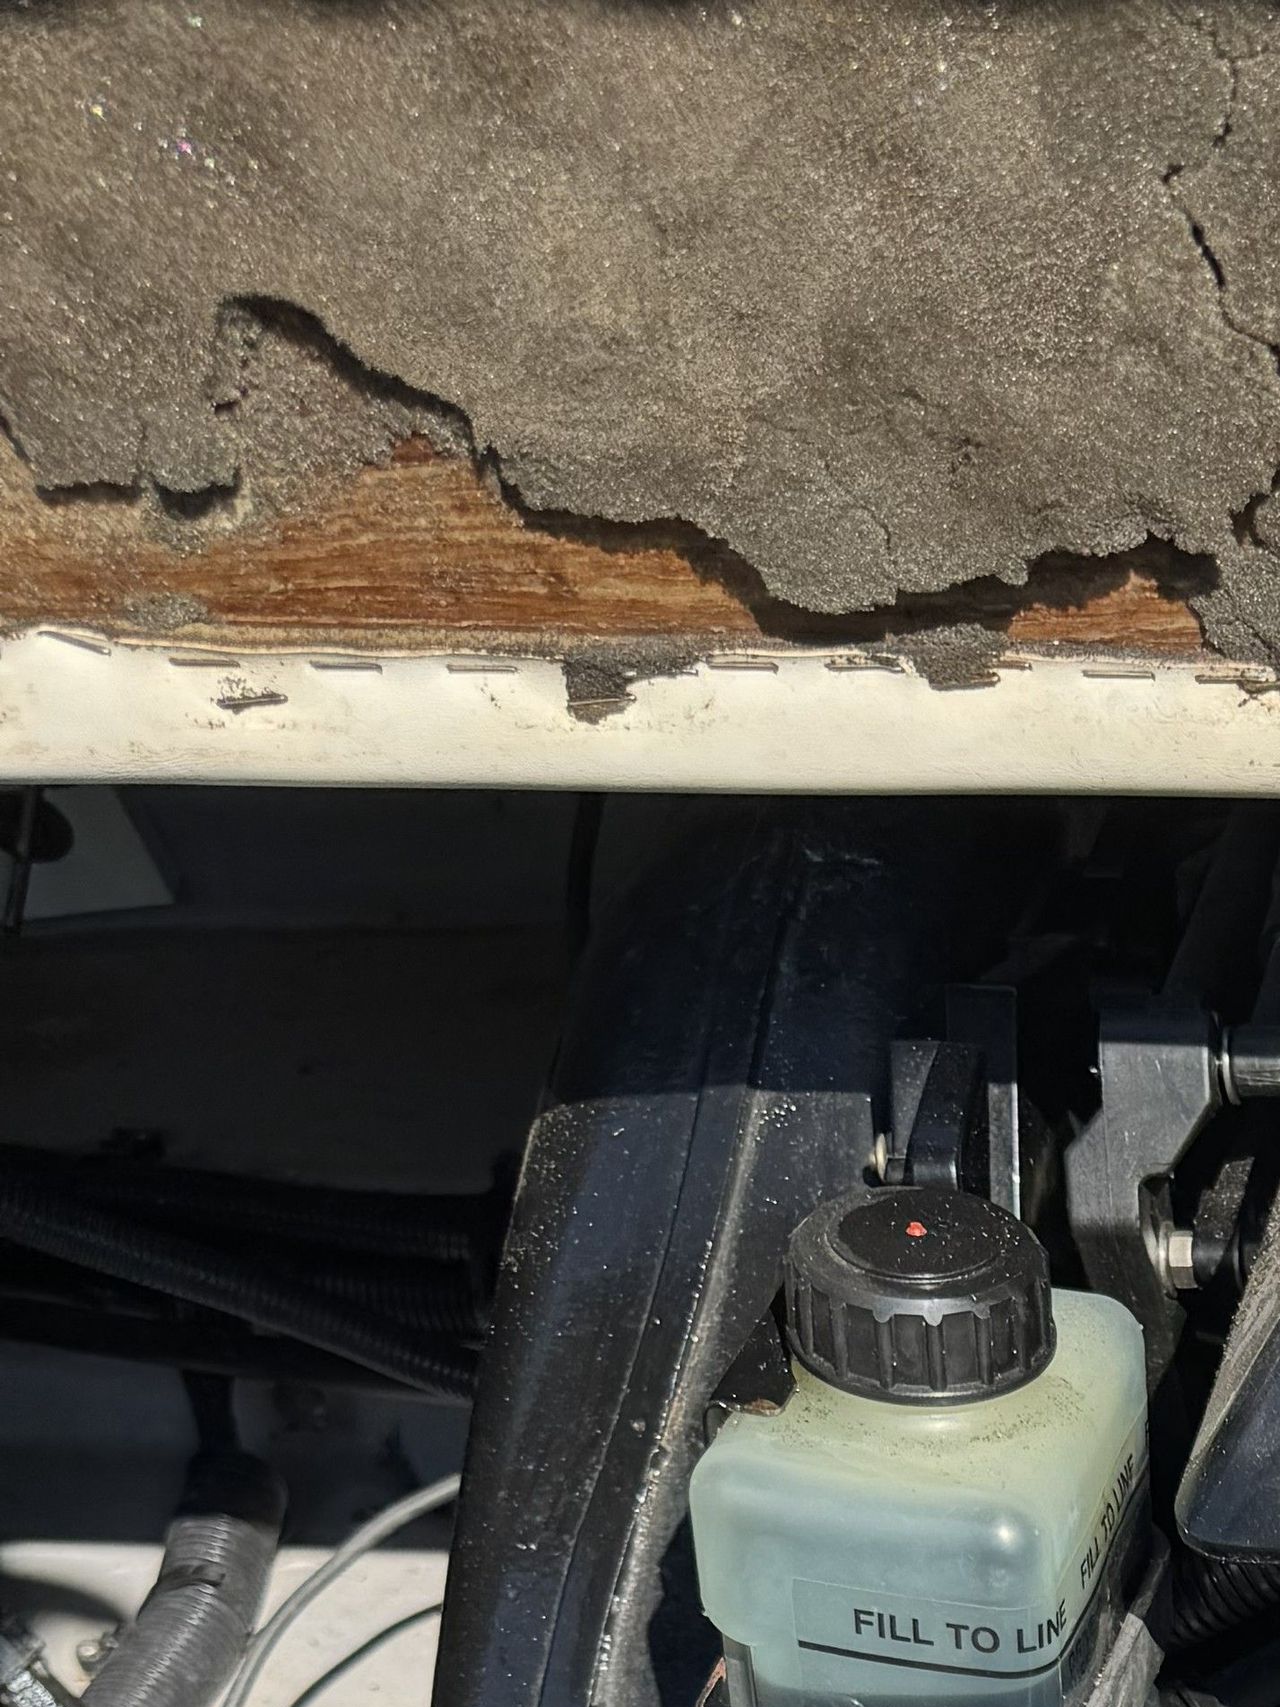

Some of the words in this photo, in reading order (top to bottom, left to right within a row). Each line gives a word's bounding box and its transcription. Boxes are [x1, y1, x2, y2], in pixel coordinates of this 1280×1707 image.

[853, 1608, 935, 1646] FILL
[946, 1622, 1001, 1654] TO
[1016, 1599, 1067, 1654] LINE
